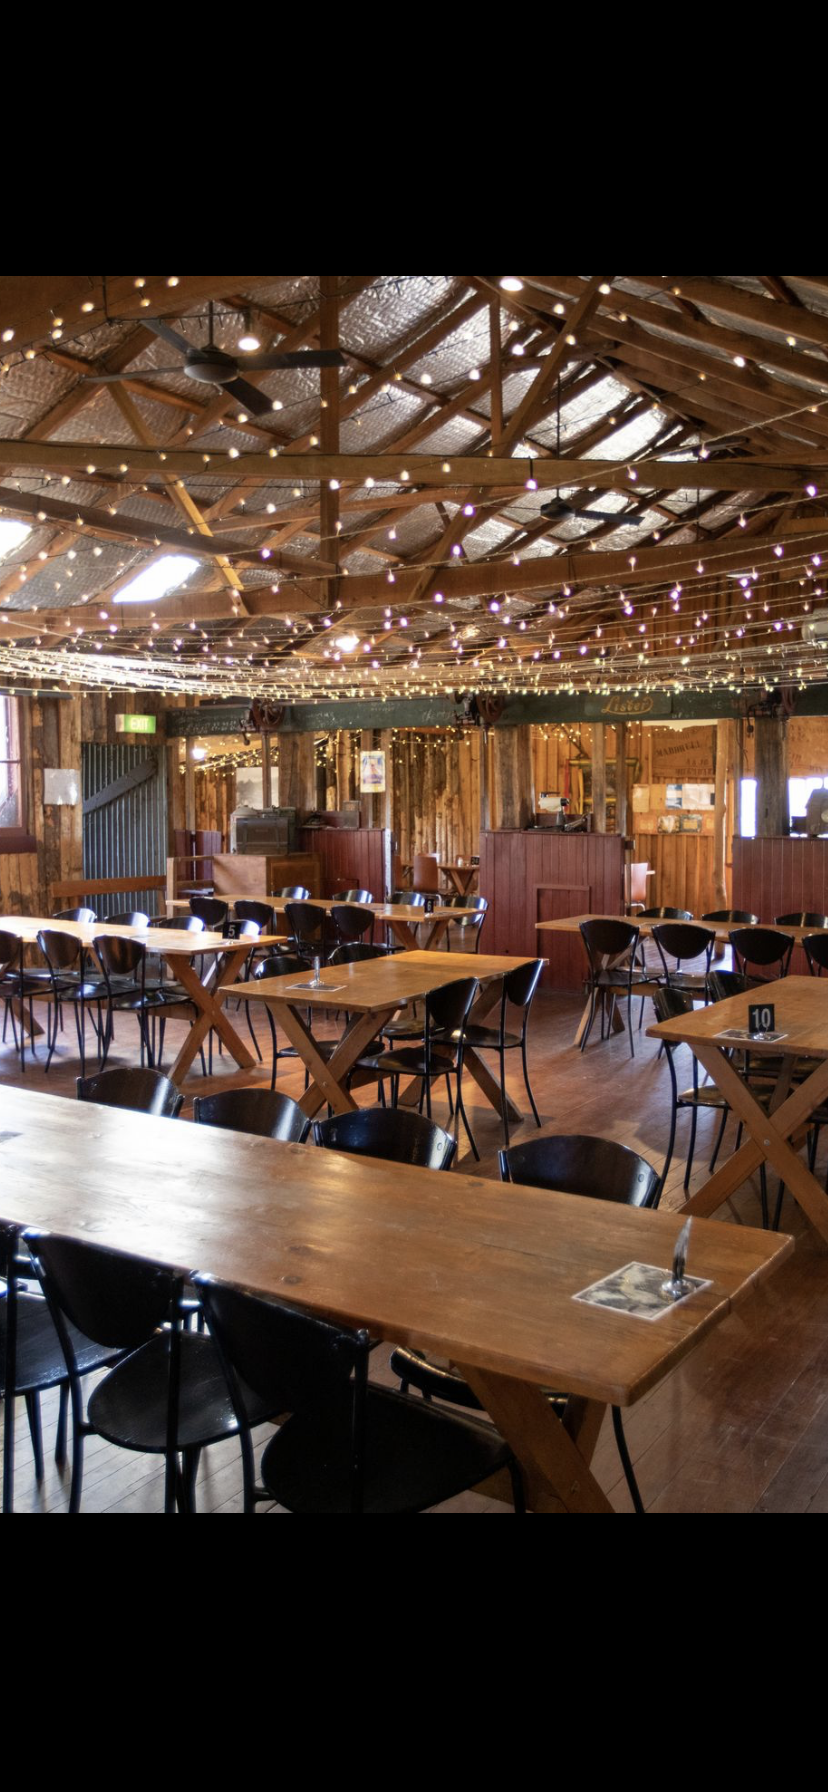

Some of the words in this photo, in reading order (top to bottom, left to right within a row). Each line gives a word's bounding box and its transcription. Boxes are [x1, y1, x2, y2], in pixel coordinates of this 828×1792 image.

[601, 696, 654, 715] Lister
[130, 717, 149, 730] EXIT
[228, 924, 236, 937] 5
[752, 1008, 771, 1028] 10
